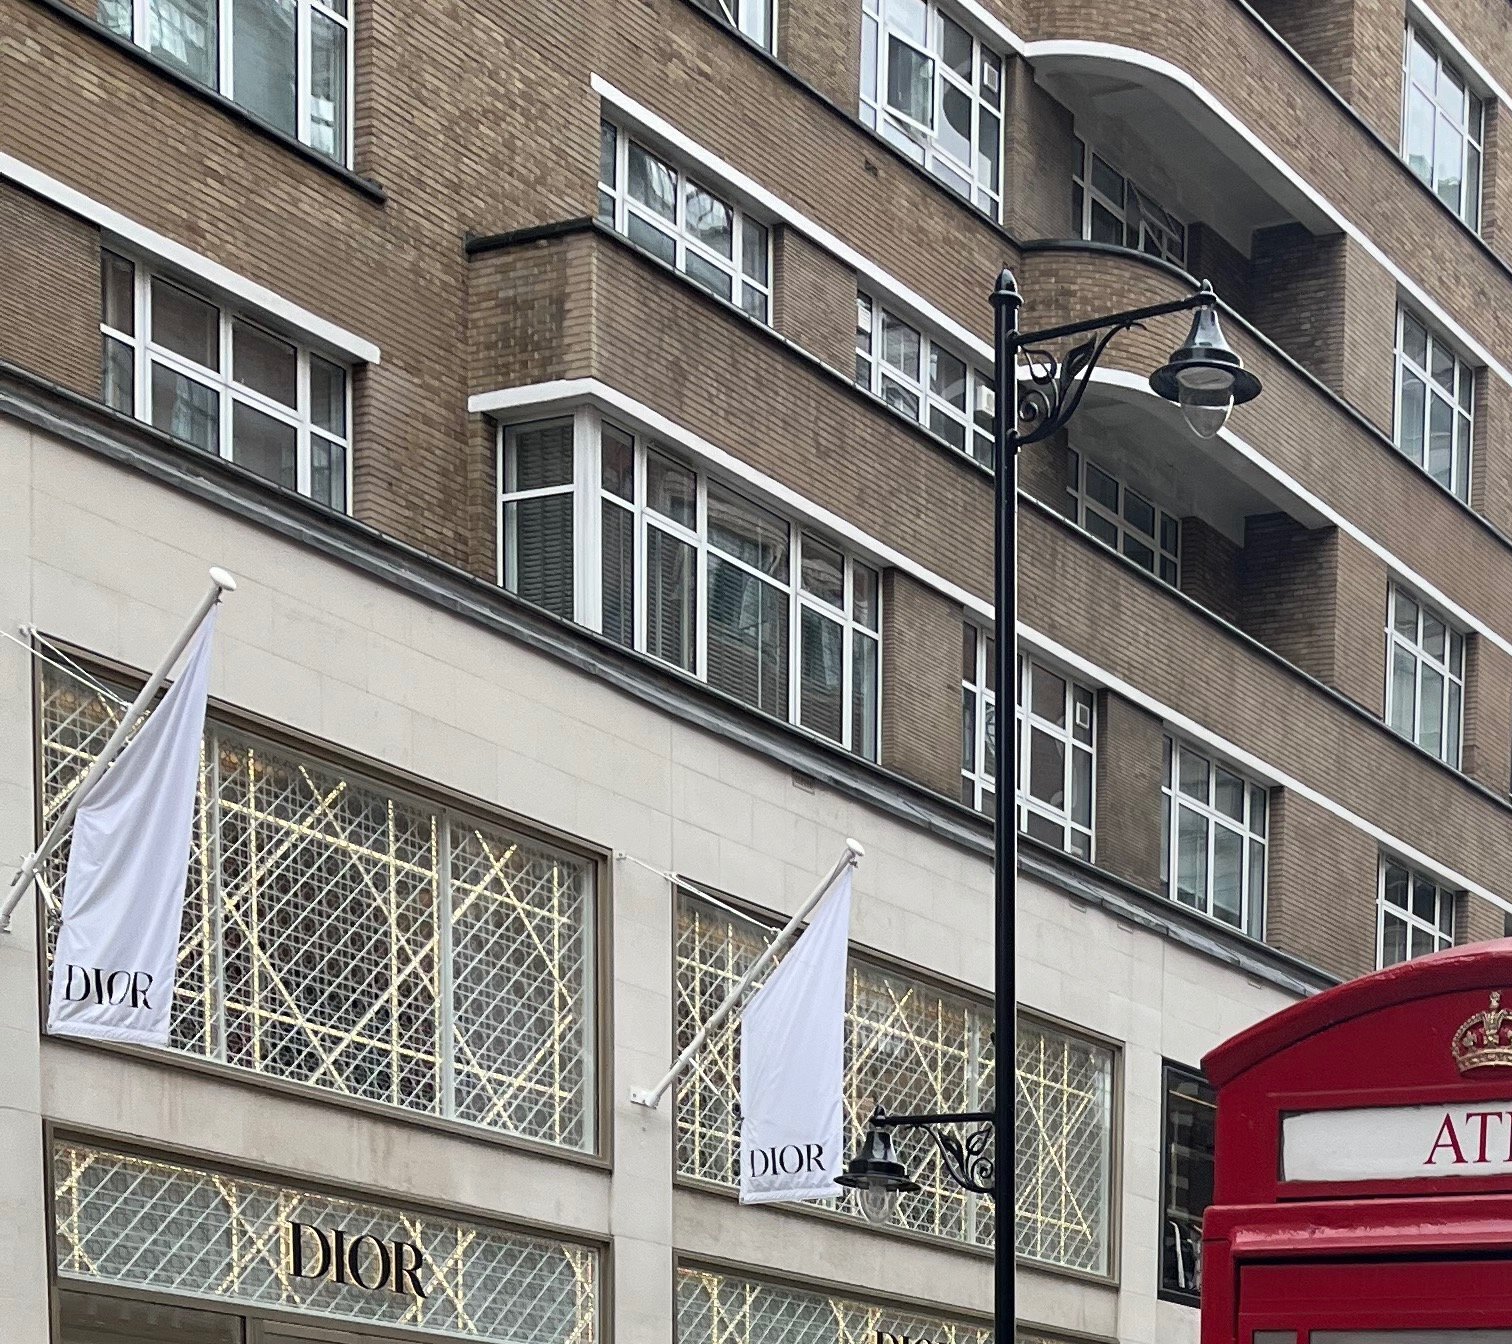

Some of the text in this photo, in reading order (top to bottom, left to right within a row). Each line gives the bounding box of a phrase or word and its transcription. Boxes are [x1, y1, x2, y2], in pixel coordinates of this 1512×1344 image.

[63, 964, 153, 1010] DIOR
[750, 1143, 826, 1177] DIOR
[286, 1220, 427, 1299] DIOR
